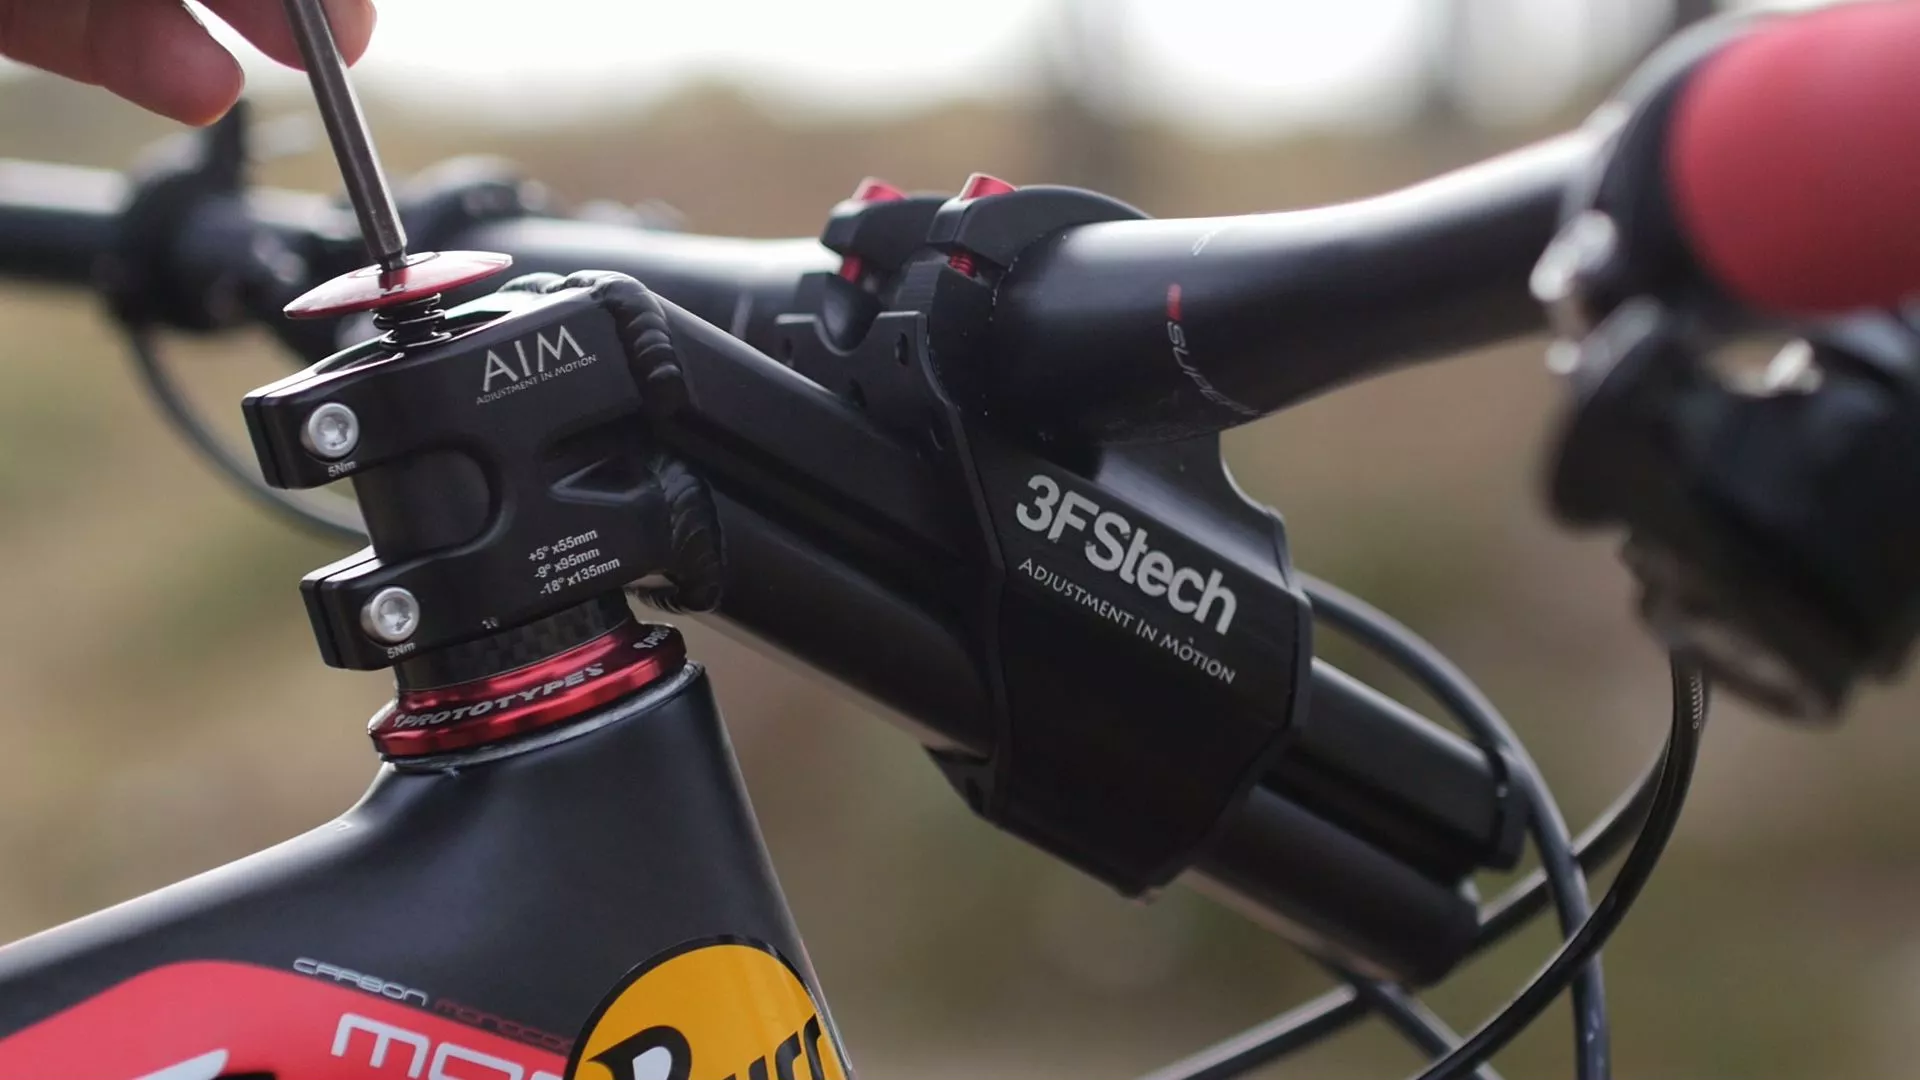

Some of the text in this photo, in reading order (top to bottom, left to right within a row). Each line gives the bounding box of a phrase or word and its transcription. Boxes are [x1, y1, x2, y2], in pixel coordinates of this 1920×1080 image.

[476, 354, 597, 405] ADJUSTMENT IN MOTION
[483, 325, 585, 392] AIM
[328, 460, 356, 477] 5Nm
[551, 529, 598, 555] x55mm
[554, 548, 600, 573] x95mm
[1016, 474, 1237, 635] 3FStech
[566, 558, 620, 587] x135mm
[1018, 558, 1236, 684] ADJUSTMENT IN MOTION
[394, 663, 604, 727] PROTOTYPES
